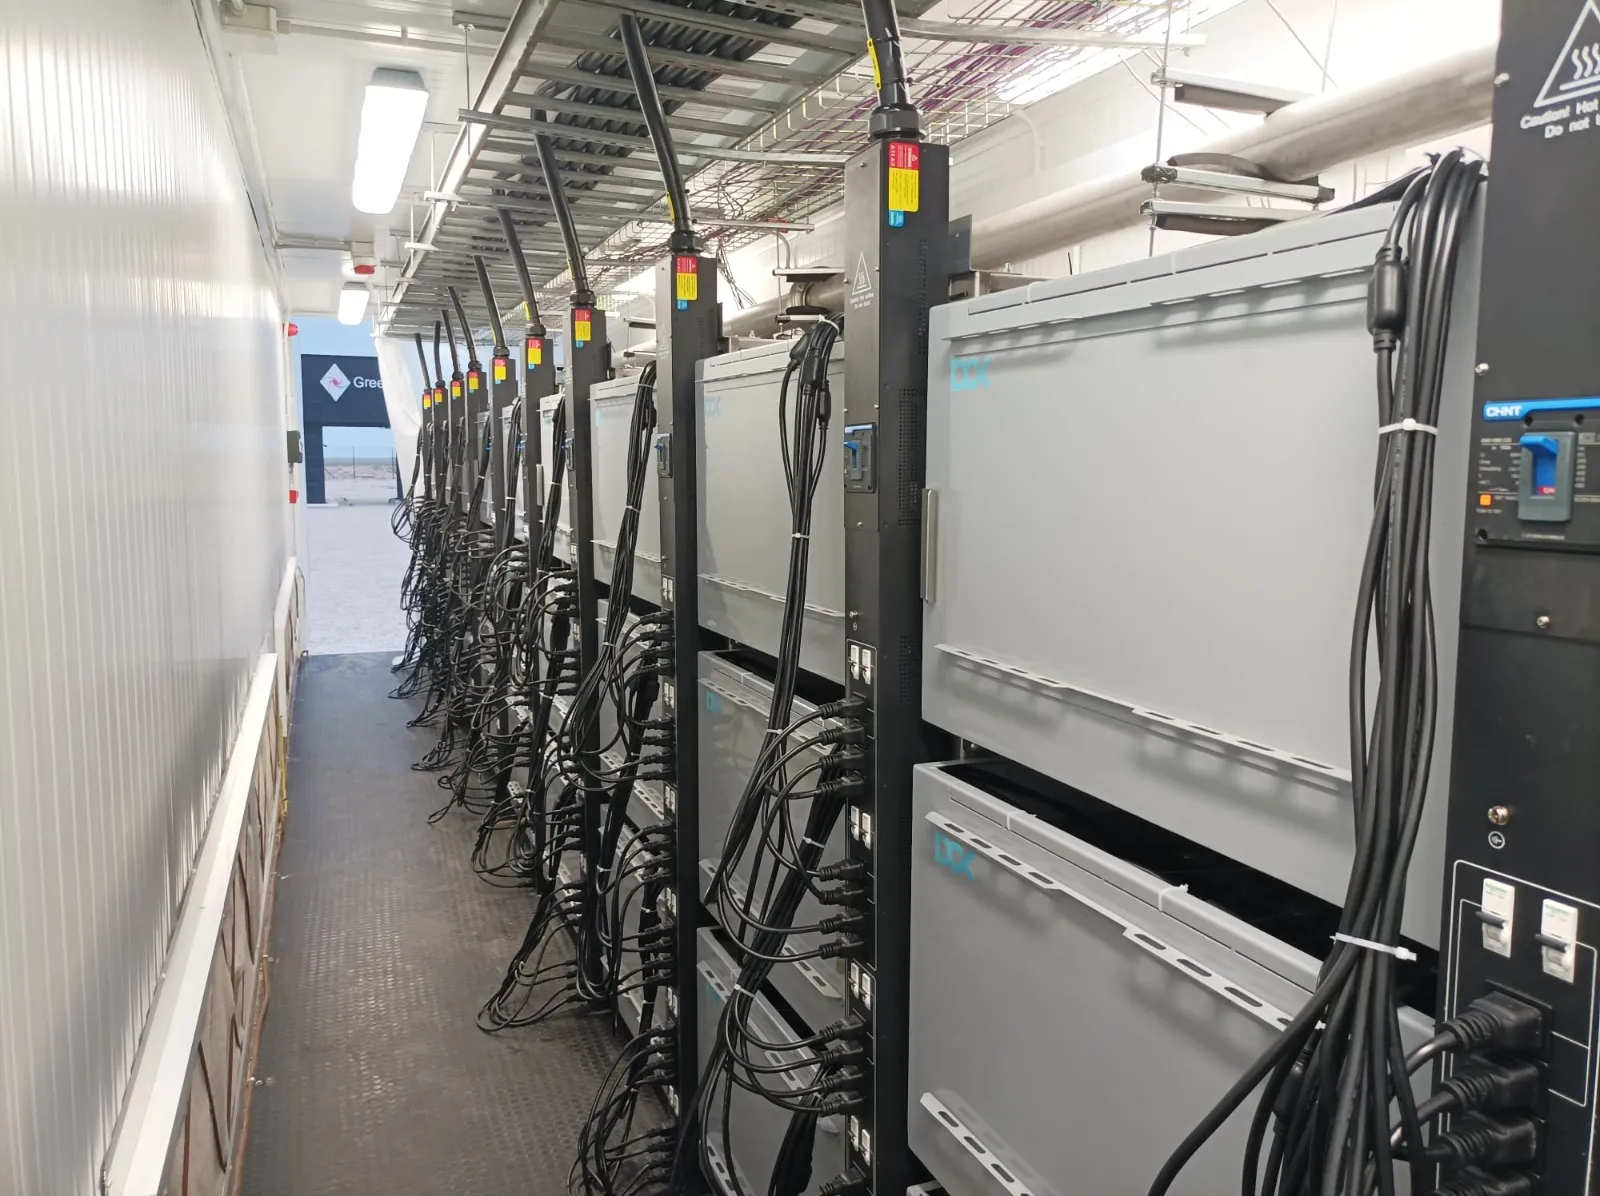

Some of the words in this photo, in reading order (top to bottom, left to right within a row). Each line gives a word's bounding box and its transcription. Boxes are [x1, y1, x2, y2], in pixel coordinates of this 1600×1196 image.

[1576, 98, 1599, 115] Hot
[1545, 125, 1564, 138] Do
[1569, 116, 1590, 132] not
